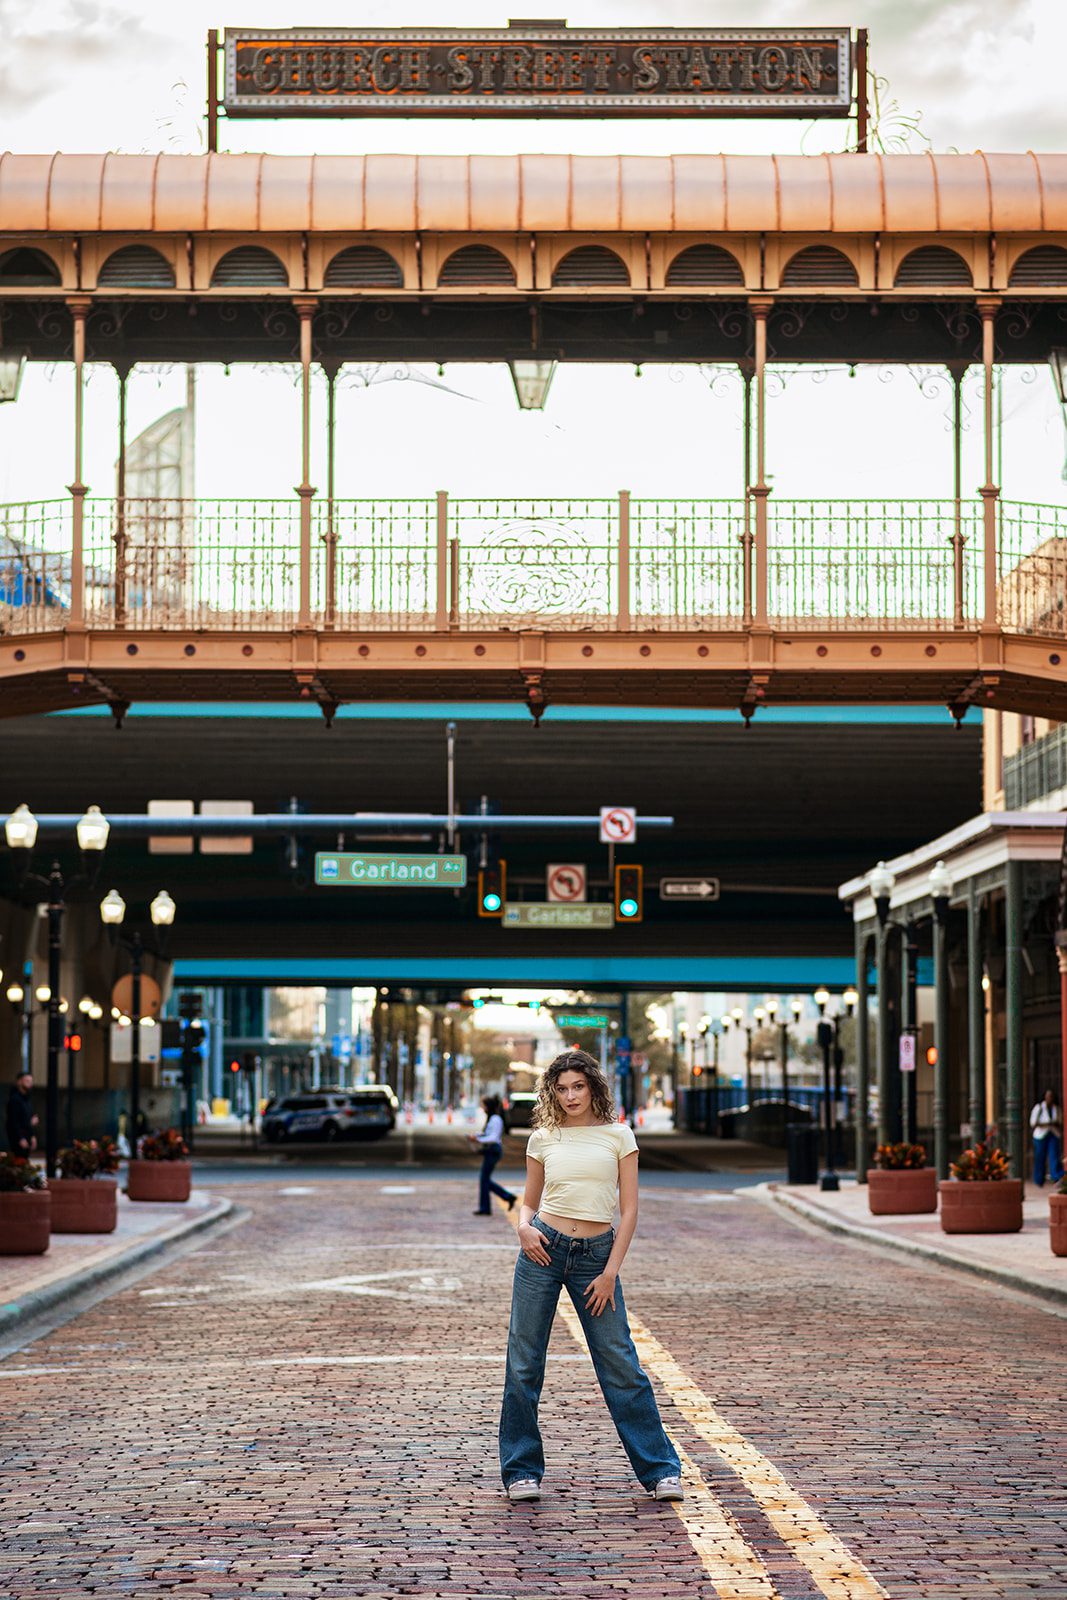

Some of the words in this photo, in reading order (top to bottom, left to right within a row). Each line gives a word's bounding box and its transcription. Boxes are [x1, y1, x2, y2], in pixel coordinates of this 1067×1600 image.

[253, 47, 430, 90] CHURCH
[448, 47, 617, 89] STREET
[633, 46, 823, 89] STATION
[351, 860, 436, 879] Garland
[527, 907, 592, 923] Garland
